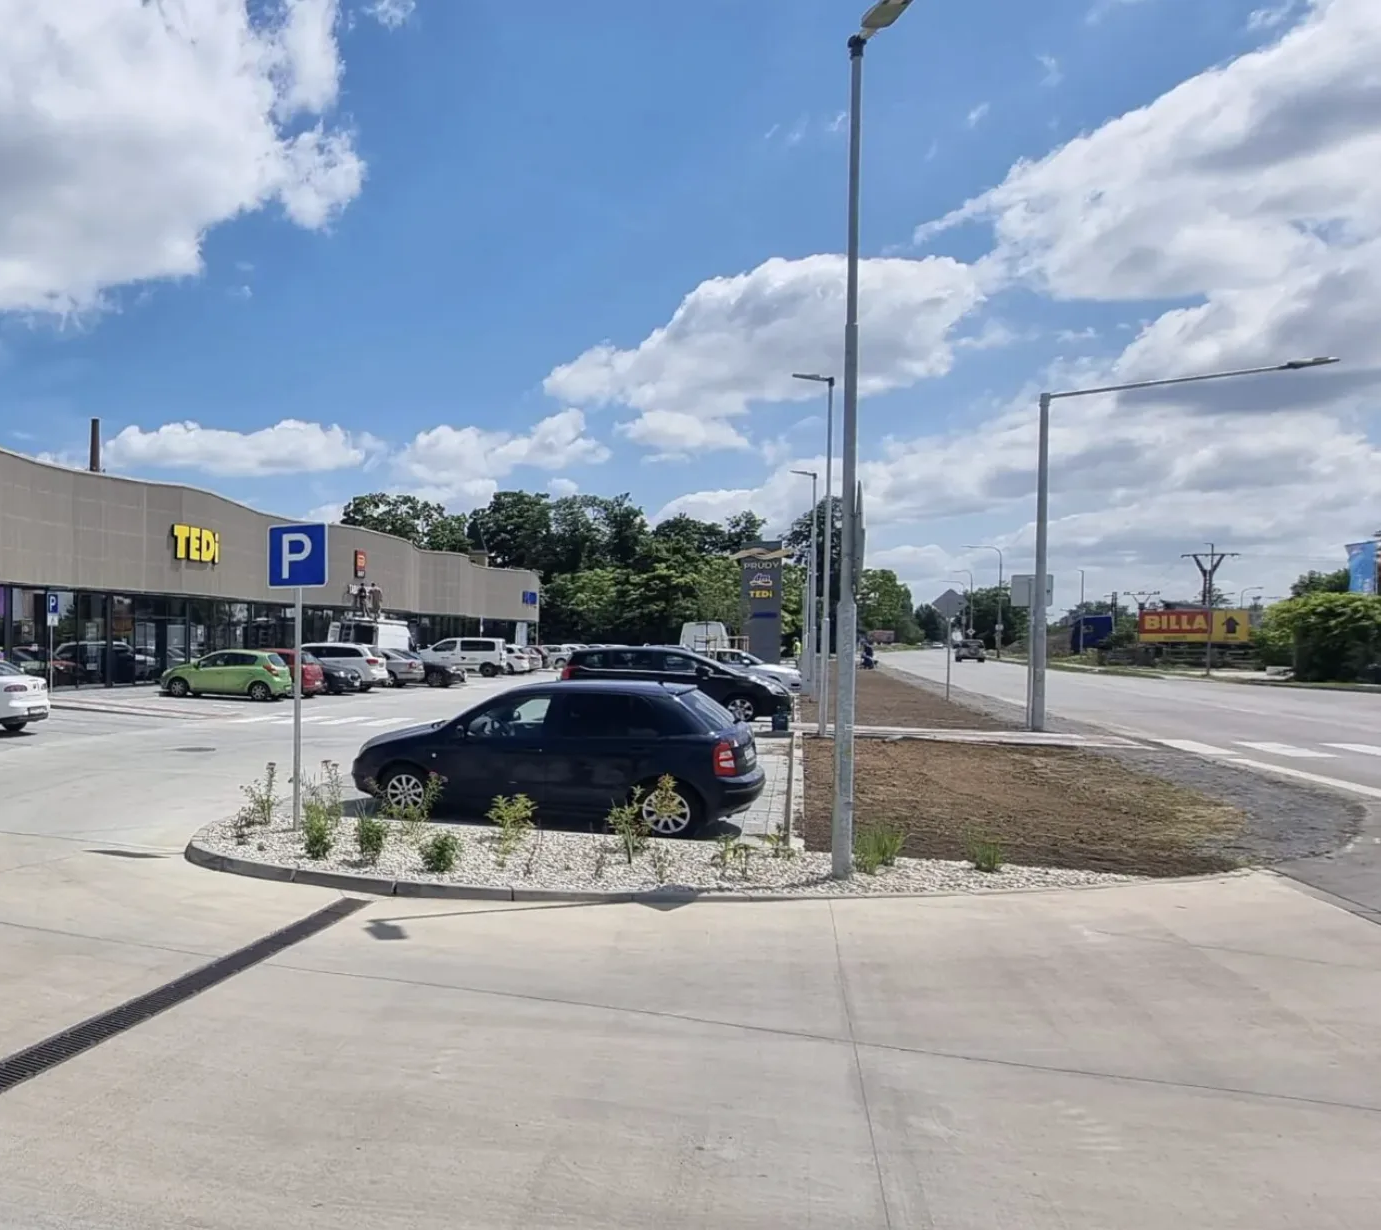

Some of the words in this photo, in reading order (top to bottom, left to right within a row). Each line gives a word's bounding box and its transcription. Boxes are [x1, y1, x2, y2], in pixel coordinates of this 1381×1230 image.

[281, 533, 312, 579] P
[49, 596, 56, 611] P
[1144, 614, 1208, 630] BILLA
